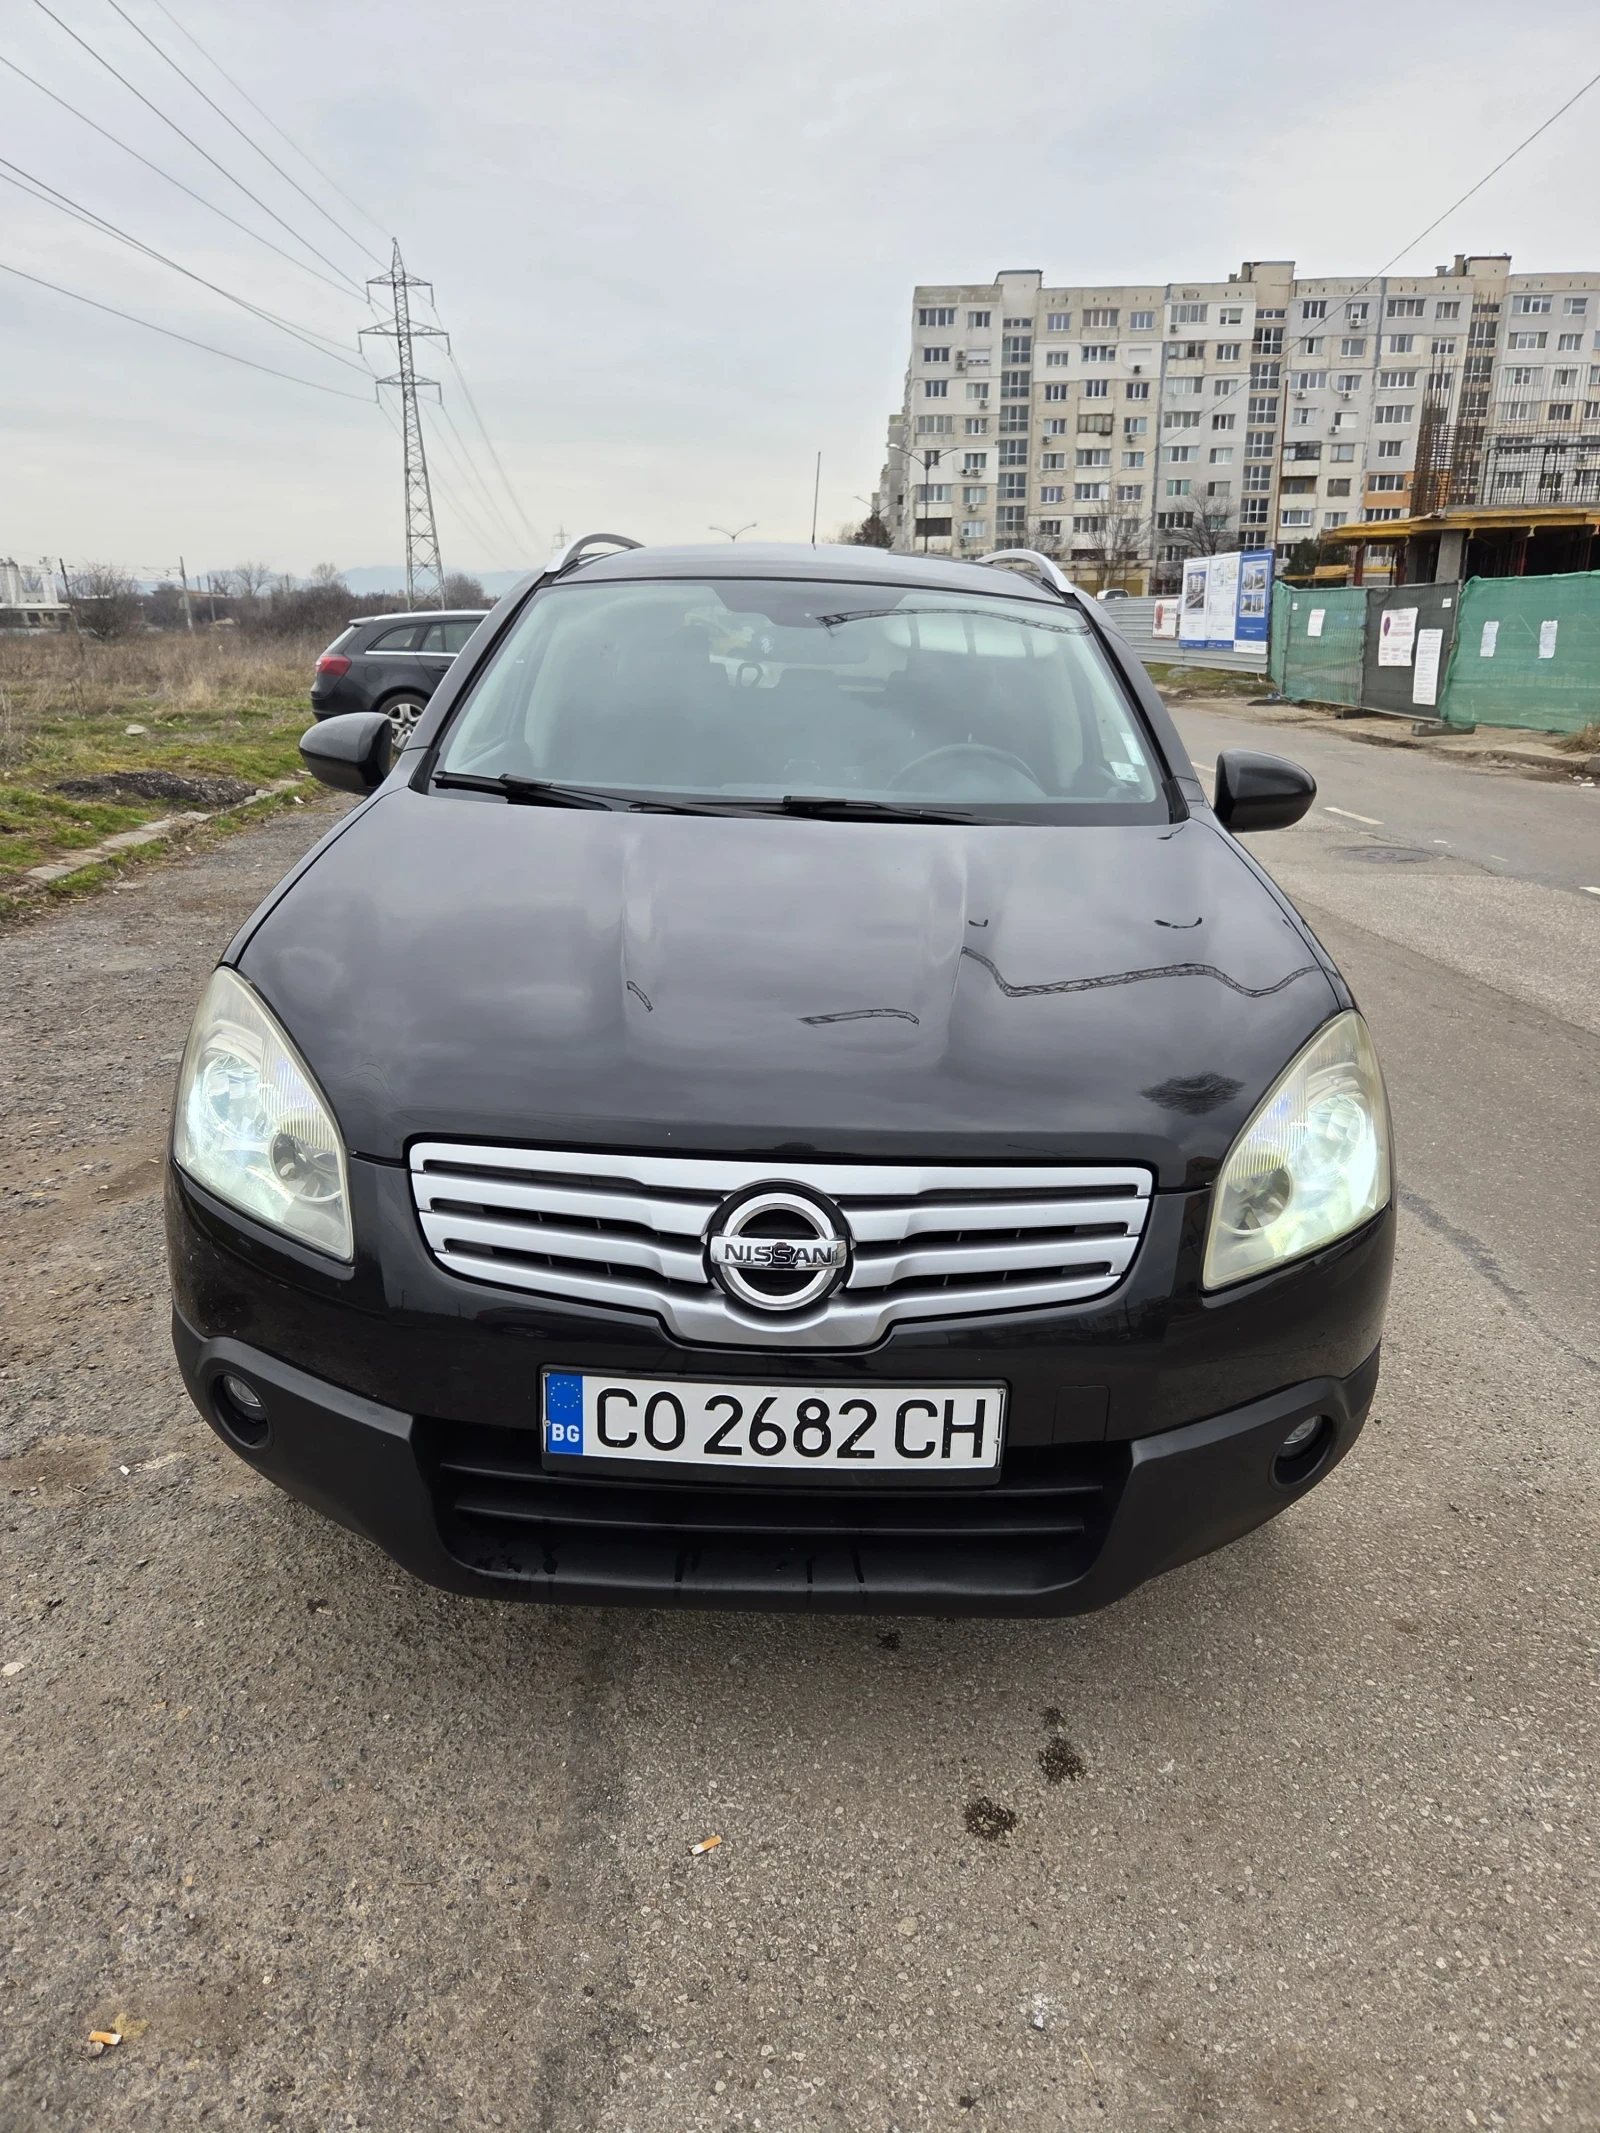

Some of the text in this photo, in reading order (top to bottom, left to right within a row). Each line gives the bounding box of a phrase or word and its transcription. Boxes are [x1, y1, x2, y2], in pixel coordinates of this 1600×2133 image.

[724, 1243, 832, 1264] NISSAN
[551, 1423, 580, 1443] BG
[596, 1387, 987, 1460] CO 2682 CH
